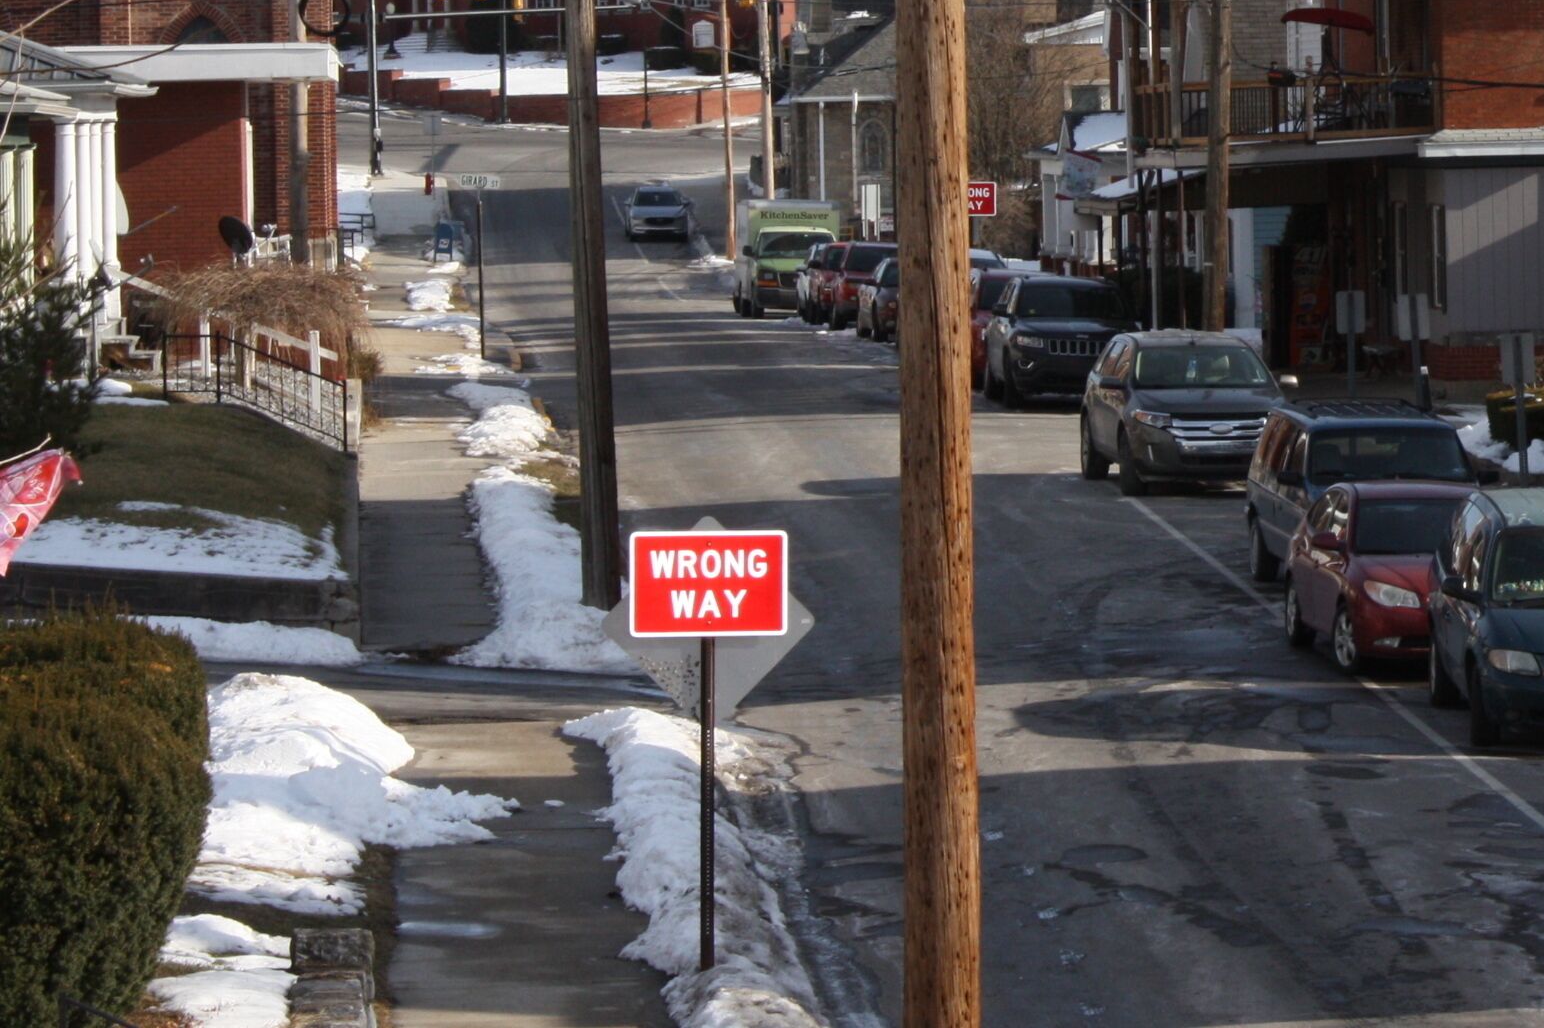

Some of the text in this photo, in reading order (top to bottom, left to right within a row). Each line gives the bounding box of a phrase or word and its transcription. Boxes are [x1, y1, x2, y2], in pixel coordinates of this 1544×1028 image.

[461, 175, 488, 187] GIRARD
[968, 187, 990, 198] ONG
[968, 200, 983, 210] AY
[650, 549, 768, 579] WRONG
[670, 589, 747, 619] WAY
